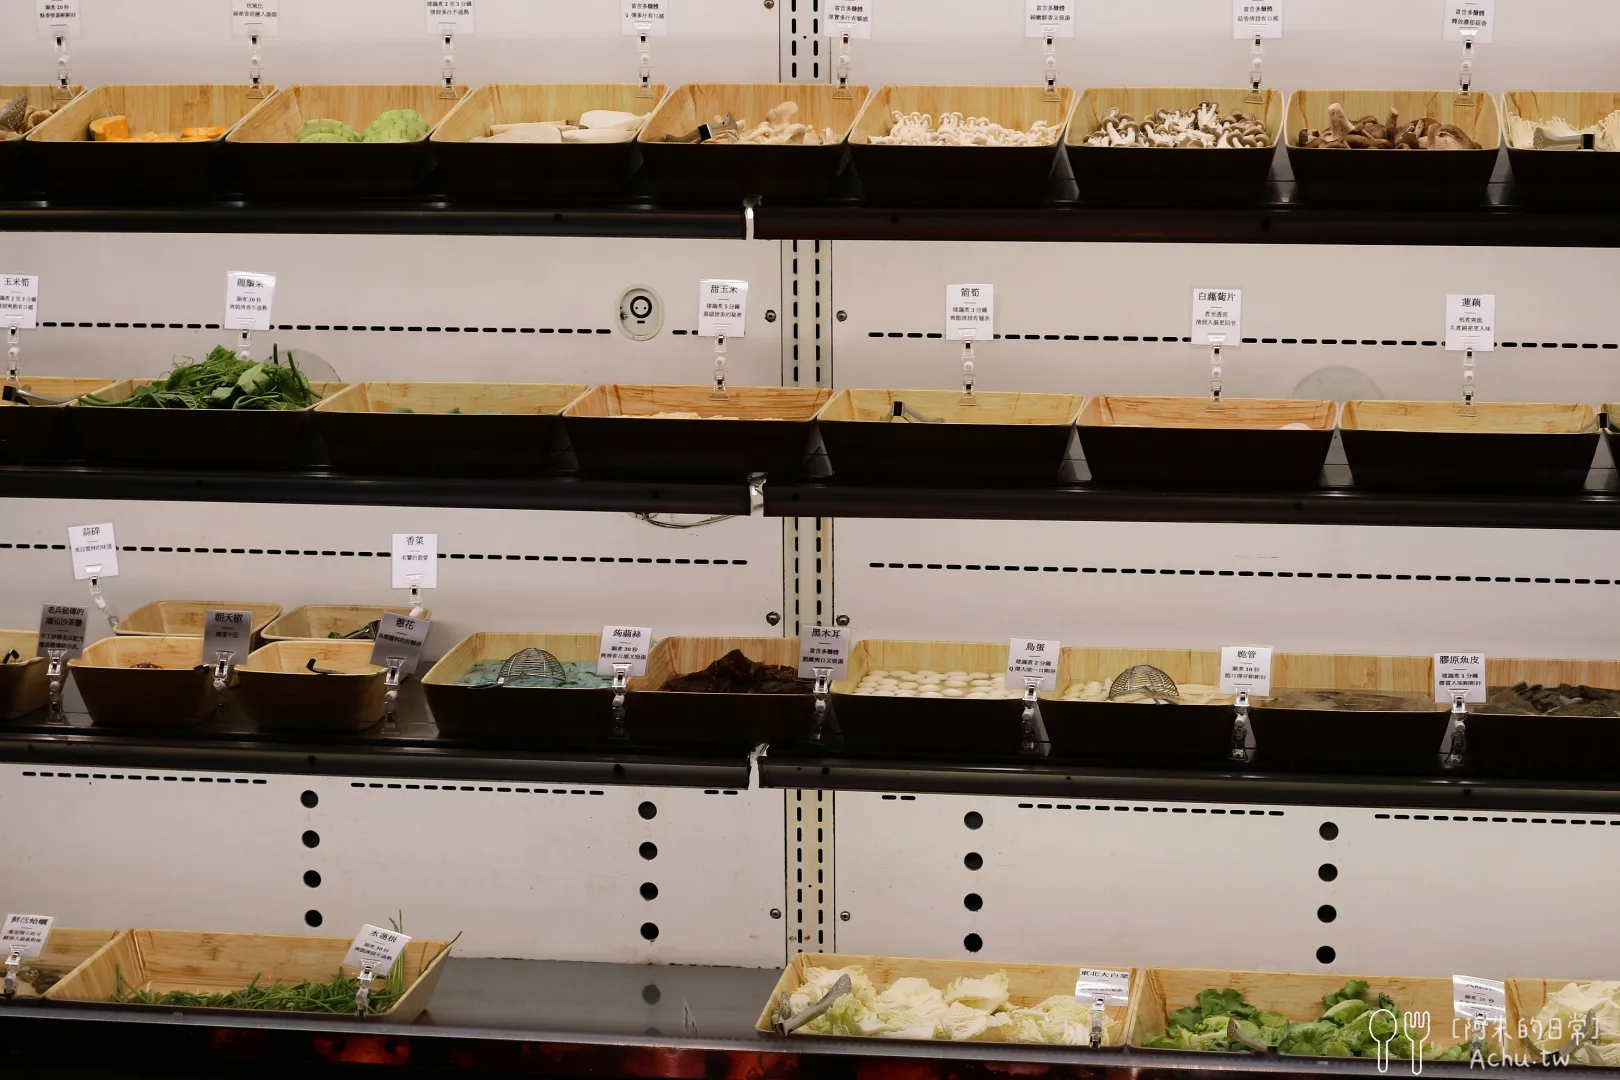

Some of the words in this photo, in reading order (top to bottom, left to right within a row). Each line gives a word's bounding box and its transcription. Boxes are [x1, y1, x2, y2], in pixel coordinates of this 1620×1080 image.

[4, 278, 29, 287] 玉米筍
[710, 285, 738, 293] 甜玉米
[961, 288, 980, 297] 箭筍
[1198, 292, 1236, 302] 白蘿蔔片
[1462, 298, 1481, 308] 蓮藕
[82, 527, 100, 537] 蒜碎
[406, 536, 424, 545] 香菜
[47, 606, 84, 616] 老兵秘傳的
[46, 617, 82, 627] 潮汕沙茶醬
[215, 612, 243, 623] 朝天椒
[395, 618, 415, 630] 蔥花
[613, 629, 641, 638] 蒟蒻絲
[812, 628, 841, 638] 黑木耳
[1025, 643, 1045, 652] 鳥蛋
[1237, 650, 1256, 659] 脆管
[1439, 656, 1479, 664] 膠原魚皮
[11, 916, 48, 925] 鮮活蛤蠣
[1081, 970, 1129, 979] 東北大白菜
